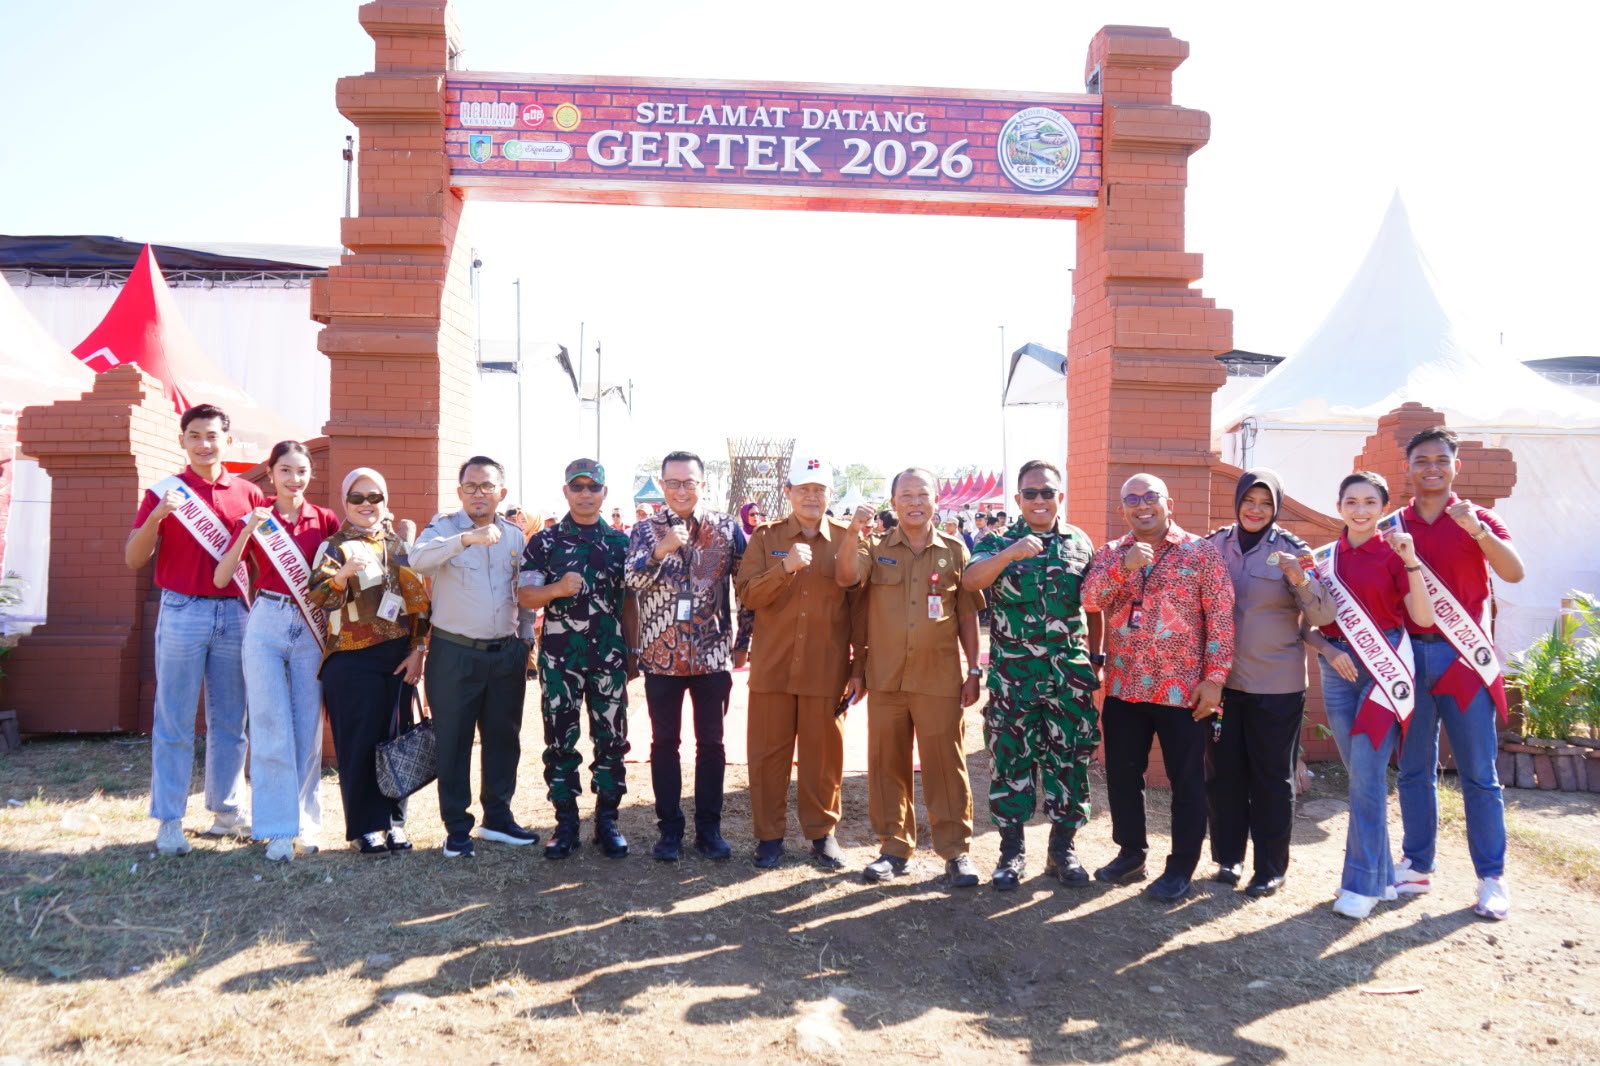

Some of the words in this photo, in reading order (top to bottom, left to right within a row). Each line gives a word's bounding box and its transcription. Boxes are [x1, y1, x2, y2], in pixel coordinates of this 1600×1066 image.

[636, 102, 790, 129] SELAMAT
[801, 107, 927, 133] DATANG
[586, 129, 822, 174] GERTEK
[839, 137, 973, 179] 2026
[1016, 166, 1060, 175] GERTEK
[179, 500, 200, 520] INU
[193, 516, 228, 552] KIRANA
[266, 533, 288, 552] INU
[277, 549, 308, 587] KIRANA
[1337, 605, 1361, 633] KAB.
[1352, 627, 1383, 661] KEDIRI
[1373, 656, 1400, 682] 2024
[1433, 596, 1462, 629] KEDIRI
[1454, 624, 1480, 650] 2024
